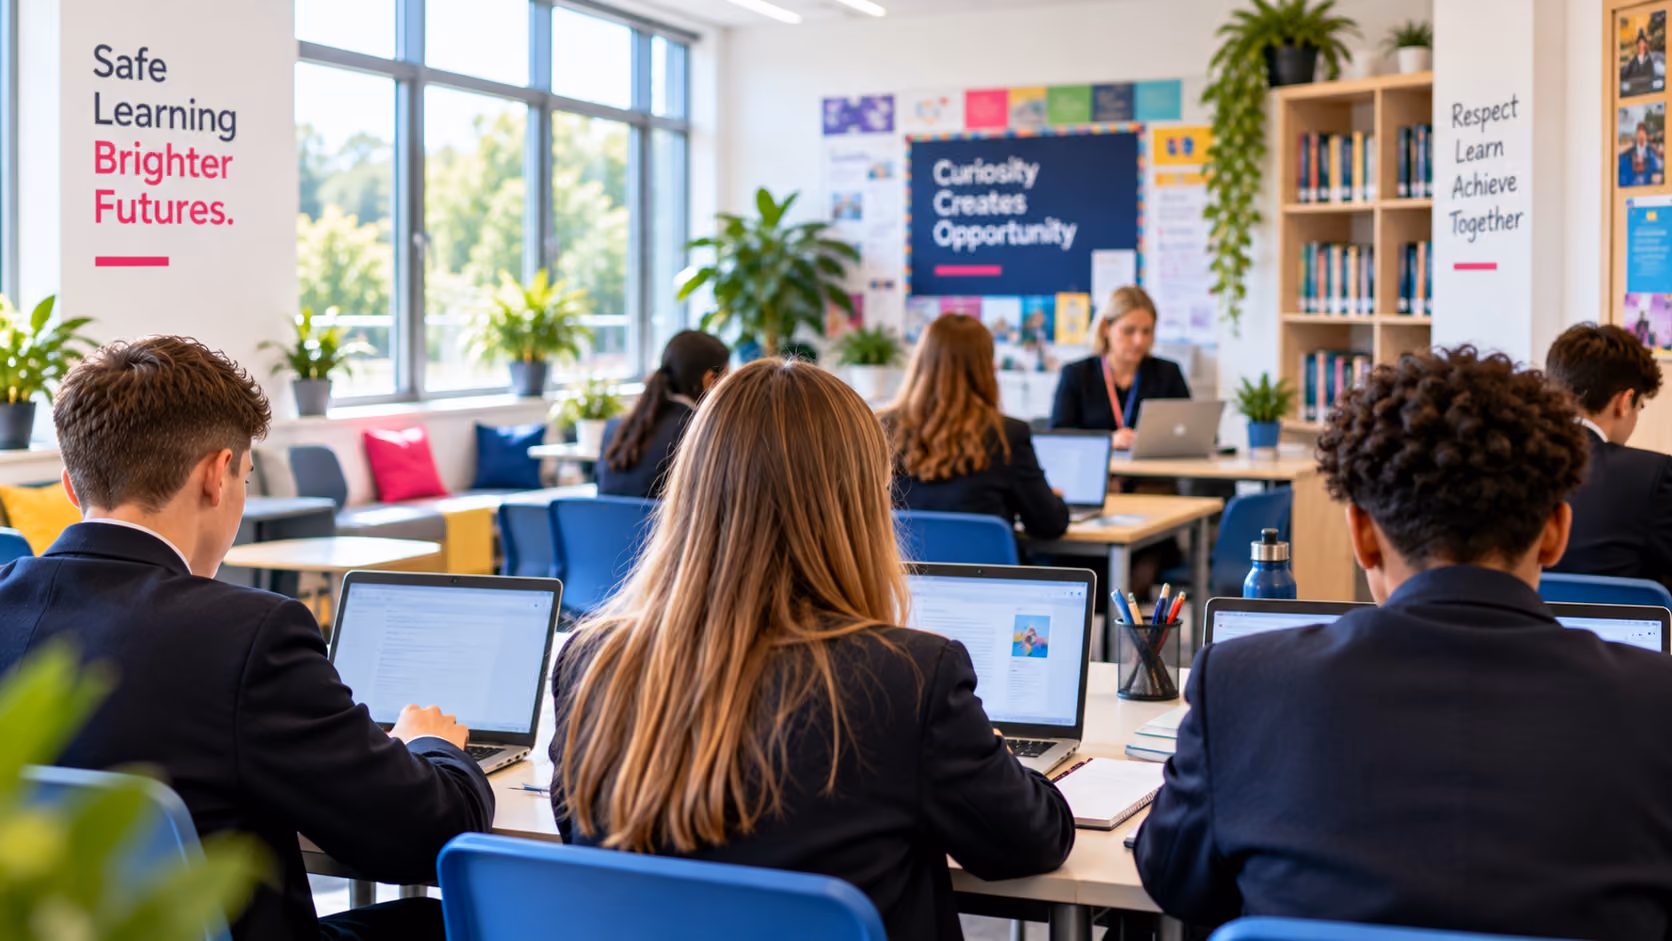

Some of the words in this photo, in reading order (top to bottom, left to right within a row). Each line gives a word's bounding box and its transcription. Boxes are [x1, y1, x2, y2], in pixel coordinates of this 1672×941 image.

[93, 44, 167, 83] Safe
[94, 91, 236, 142] Learning
[1452, 93, 1519, 133] Respect
[95, 140, 233, 186] Brighter
[1455, 138, 1504, 164] Learn
[933, 156, 1040, 189] Curiosity
[1452, 172, 1518, 199] Achieve
[95, 188, 234, 226] Futures.
[933, 189, 1028, 217] Creates
[933, 216, 1079, 253] Opportunity
[1449, 205, 1524, 243] Together
